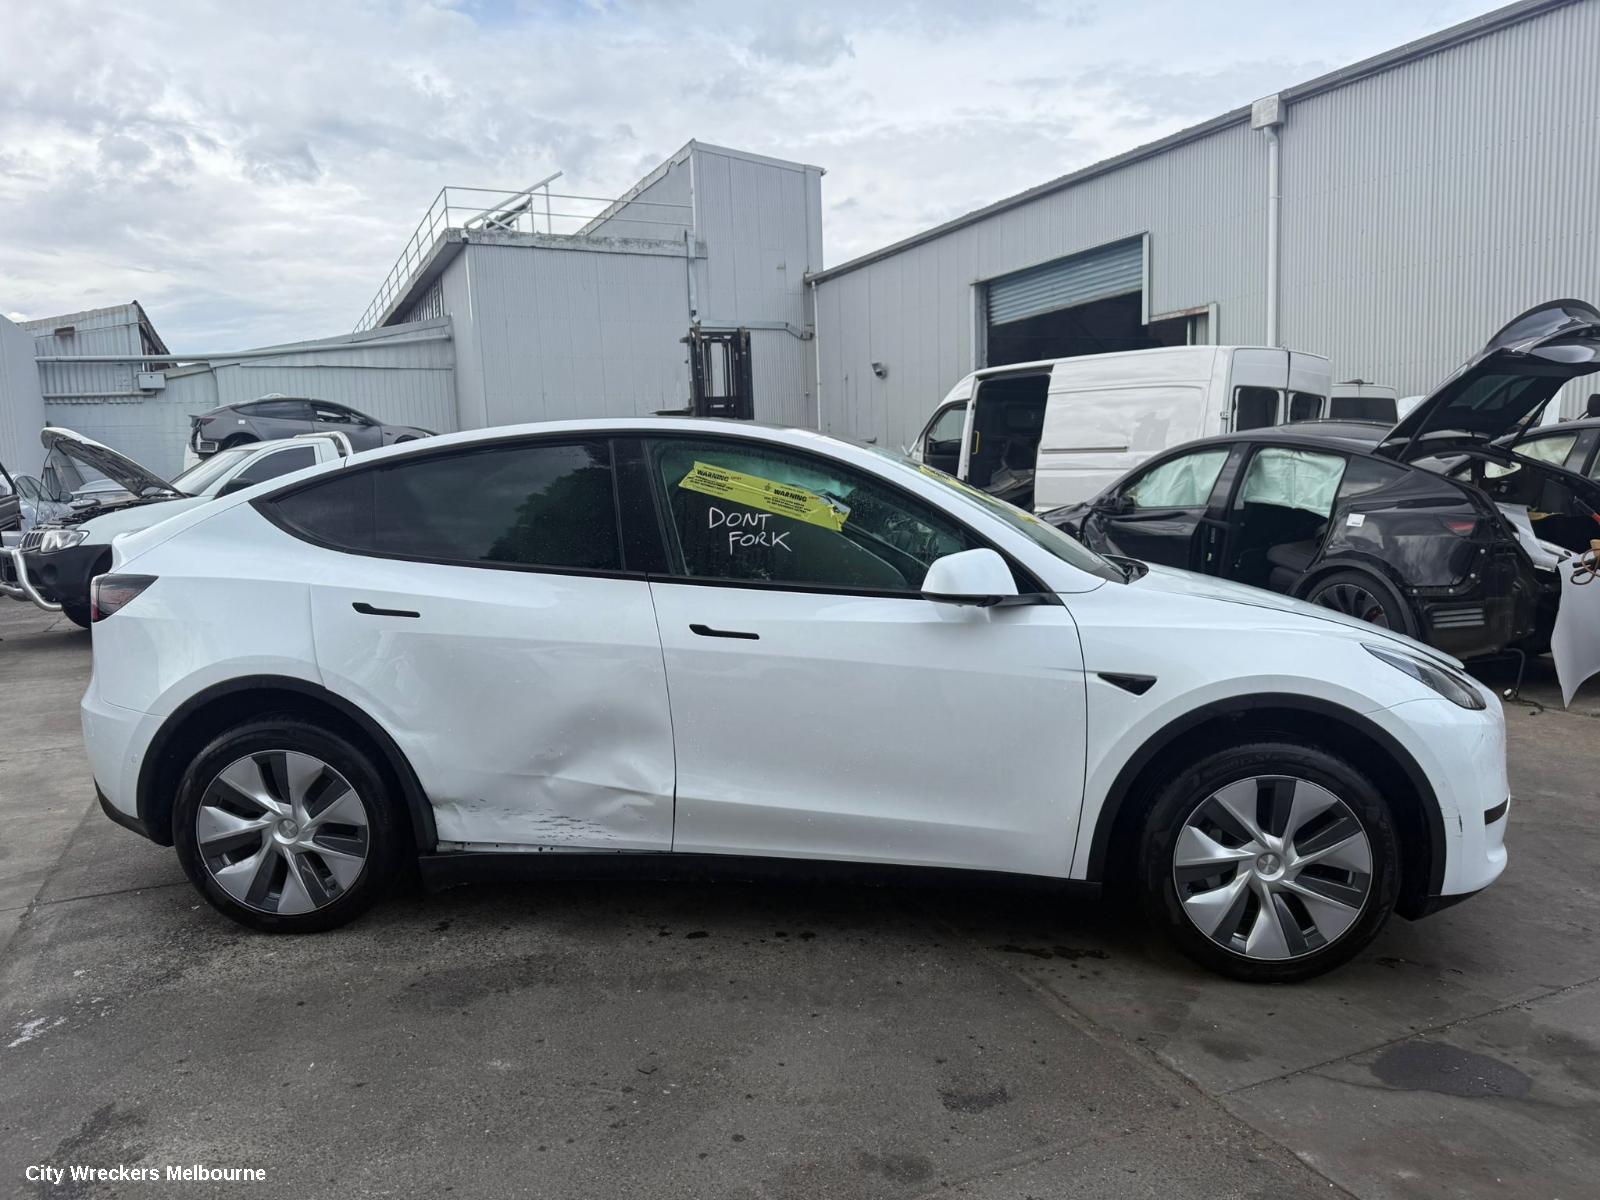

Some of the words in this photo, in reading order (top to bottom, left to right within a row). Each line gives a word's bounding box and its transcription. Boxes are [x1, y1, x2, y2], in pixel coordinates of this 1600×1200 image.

[697, 469, 729, 482] WARNING
[774, 489, 807, 502] WARNING
[708, 506, 773, 530] DONT
[728, 531, 792, 556] FORK
